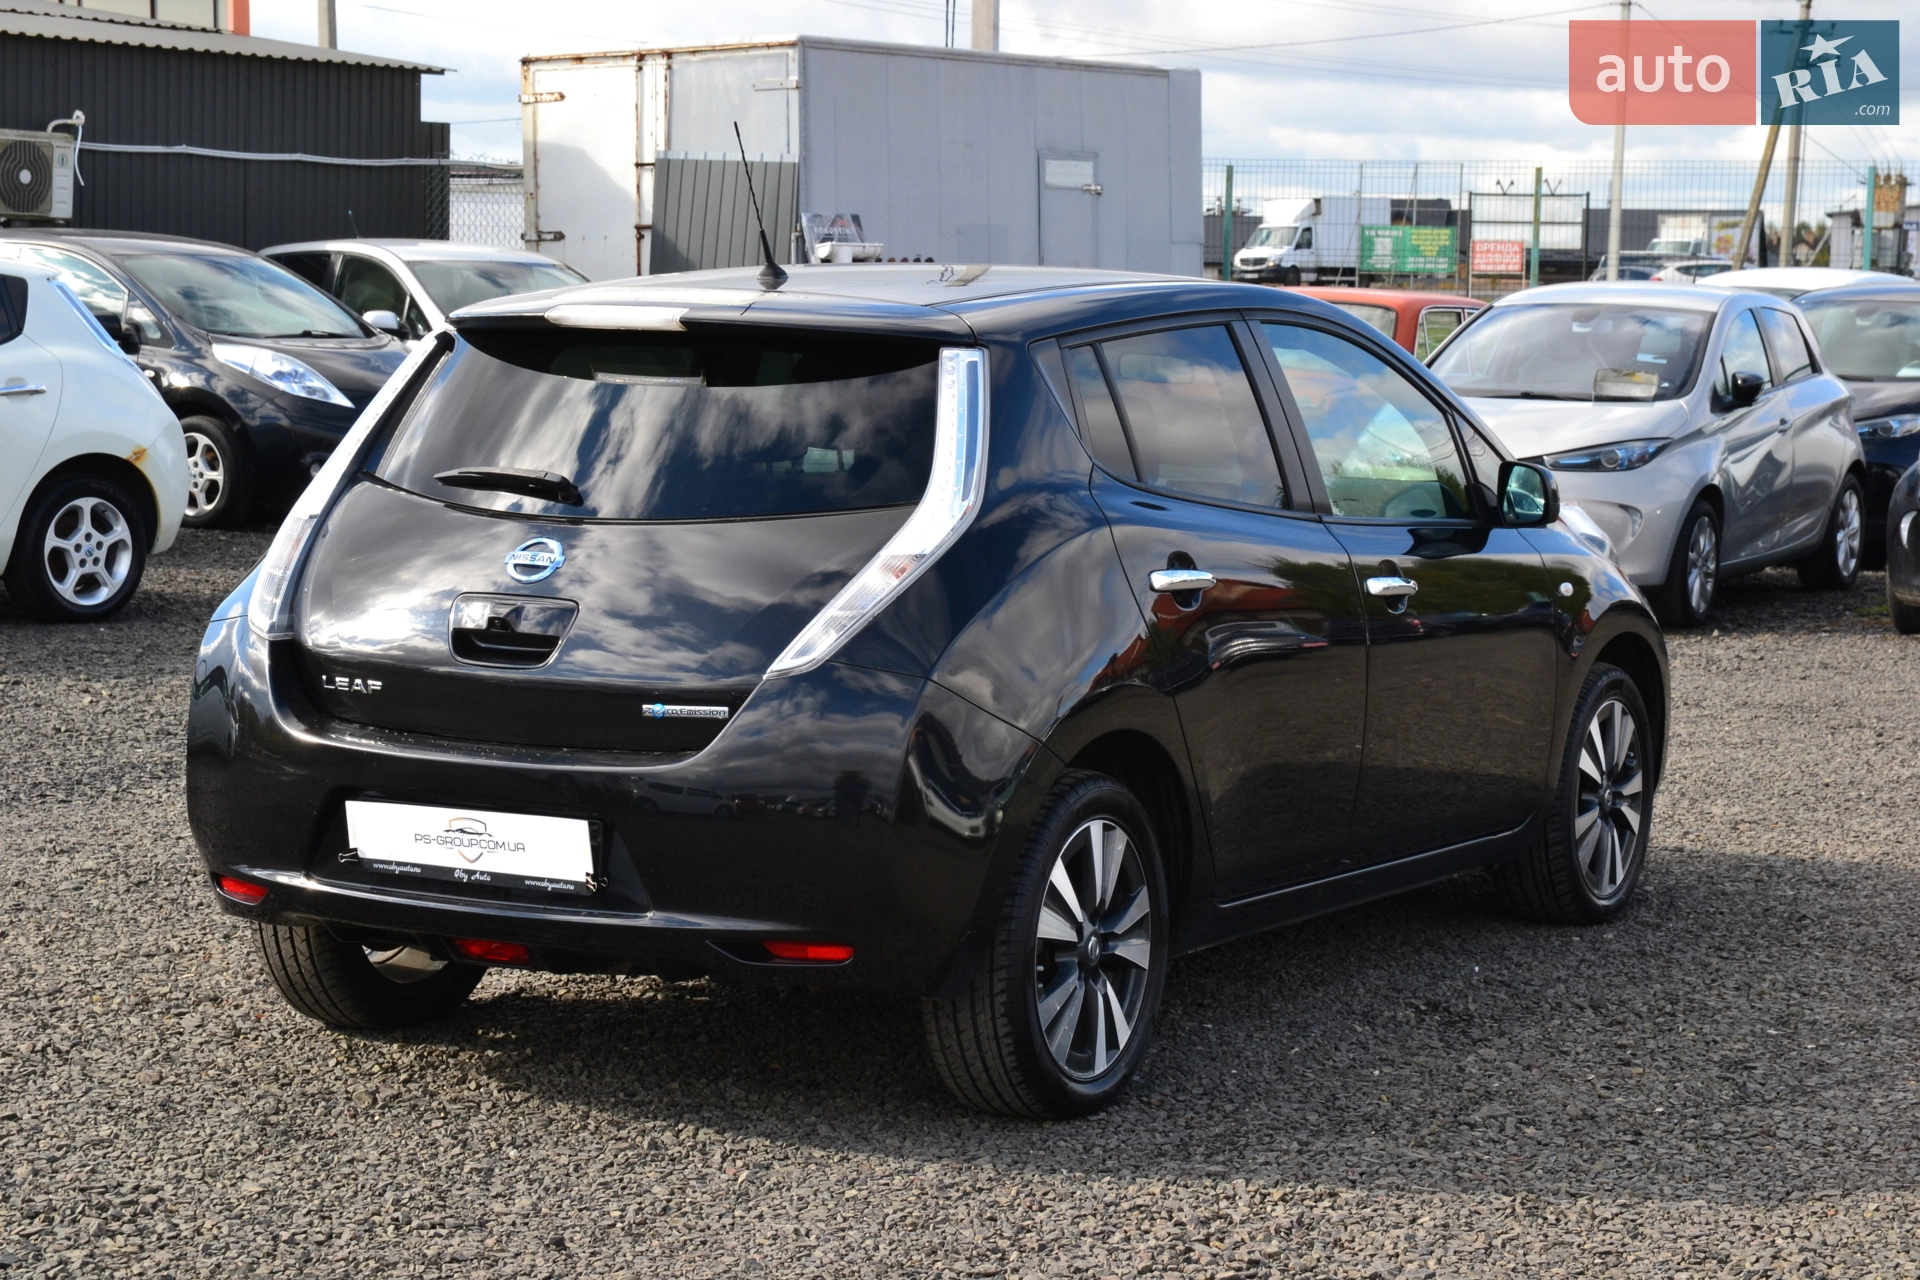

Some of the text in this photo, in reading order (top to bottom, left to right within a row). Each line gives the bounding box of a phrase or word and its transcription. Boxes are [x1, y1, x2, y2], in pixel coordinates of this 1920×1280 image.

[1475, 243, 1520, 252] ОРЕНДА
[509, 553, 557, 564] NISSAN
[321, 675, 383, 695] LEAF
[414, 833, 526, 853] PS-GROUP.COM.UA
[471, 871, 492, 881] Auto
